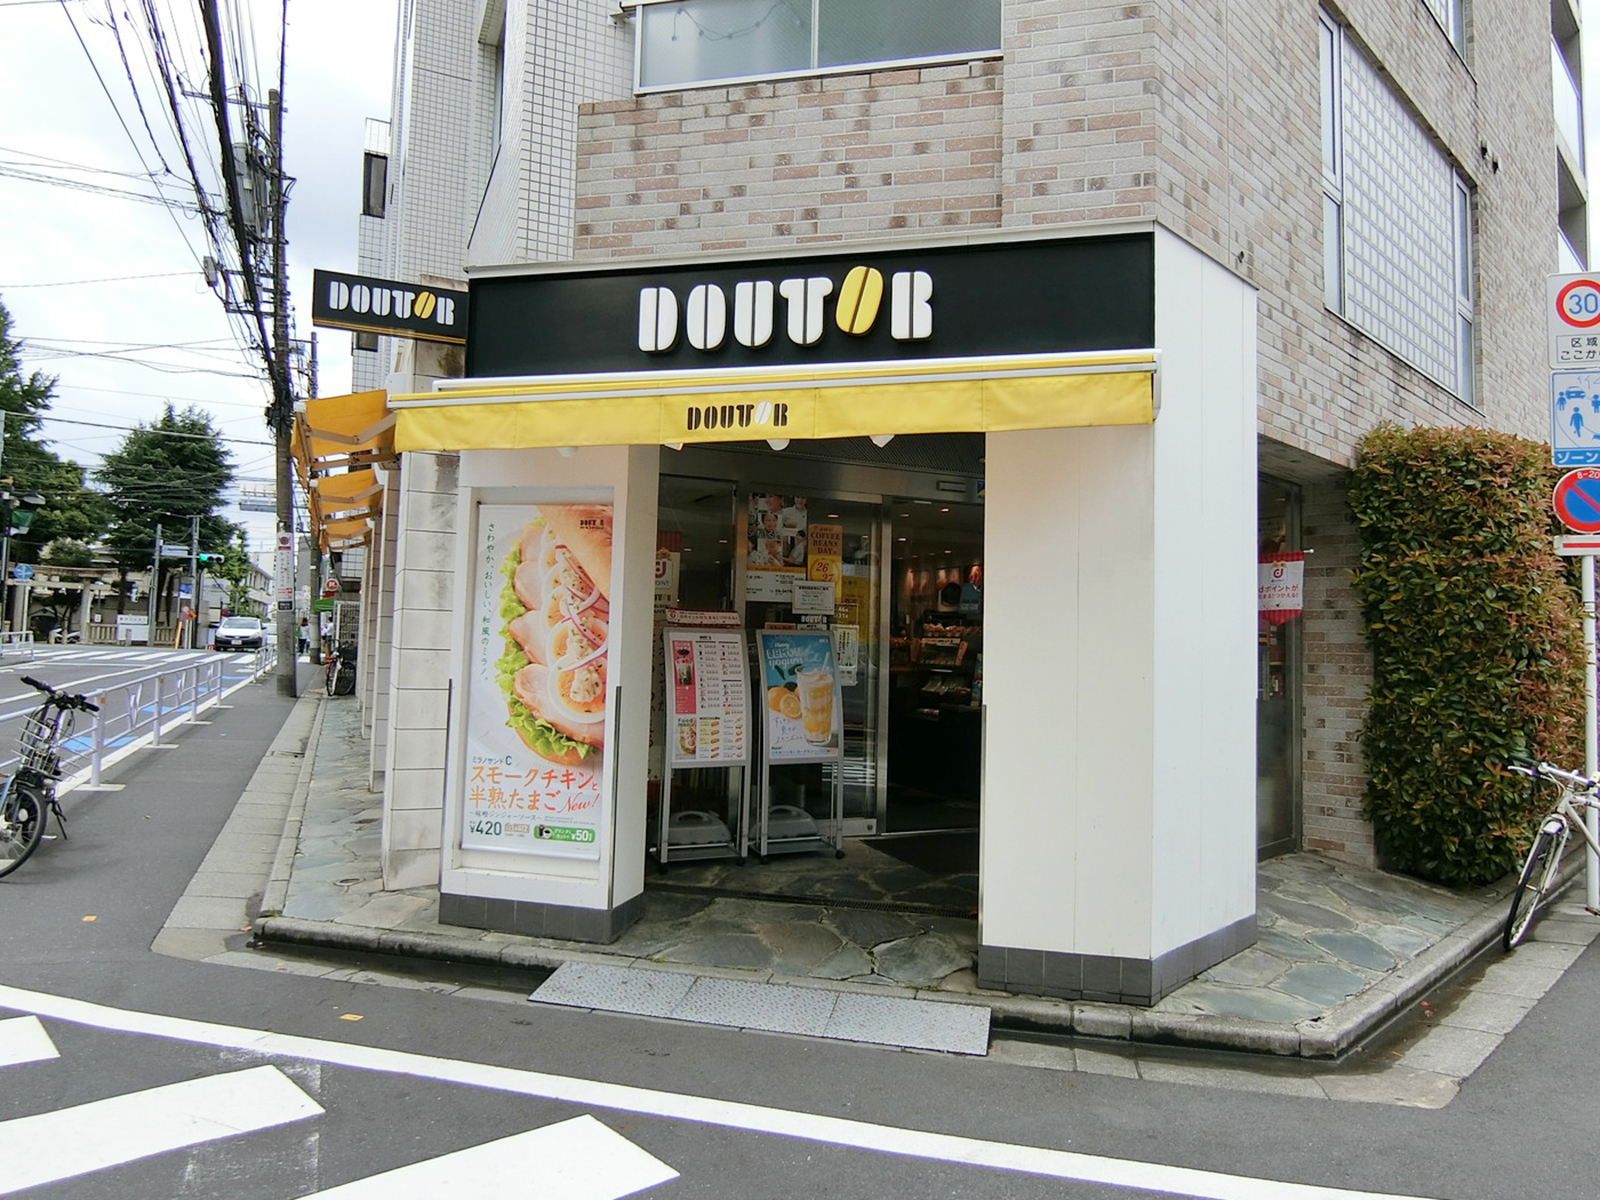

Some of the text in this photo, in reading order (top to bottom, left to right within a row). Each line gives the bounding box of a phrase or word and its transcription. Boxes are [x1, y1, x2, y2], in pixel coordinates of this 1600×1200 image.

[329, 280, 455, 326] DOUTOR
[638, 266, 933, 352] DOUTOR
[1569, 293, 1598, 315] 30
[1561, 350, 1600, 361] ここか
[687, 400, 788, 430] DOUTOR
[470, 765, 599, 793] スモークチキンと
[469, 785, 601, 814] 半熟たまご New!
[470, 820, 502, 836] ¥420
